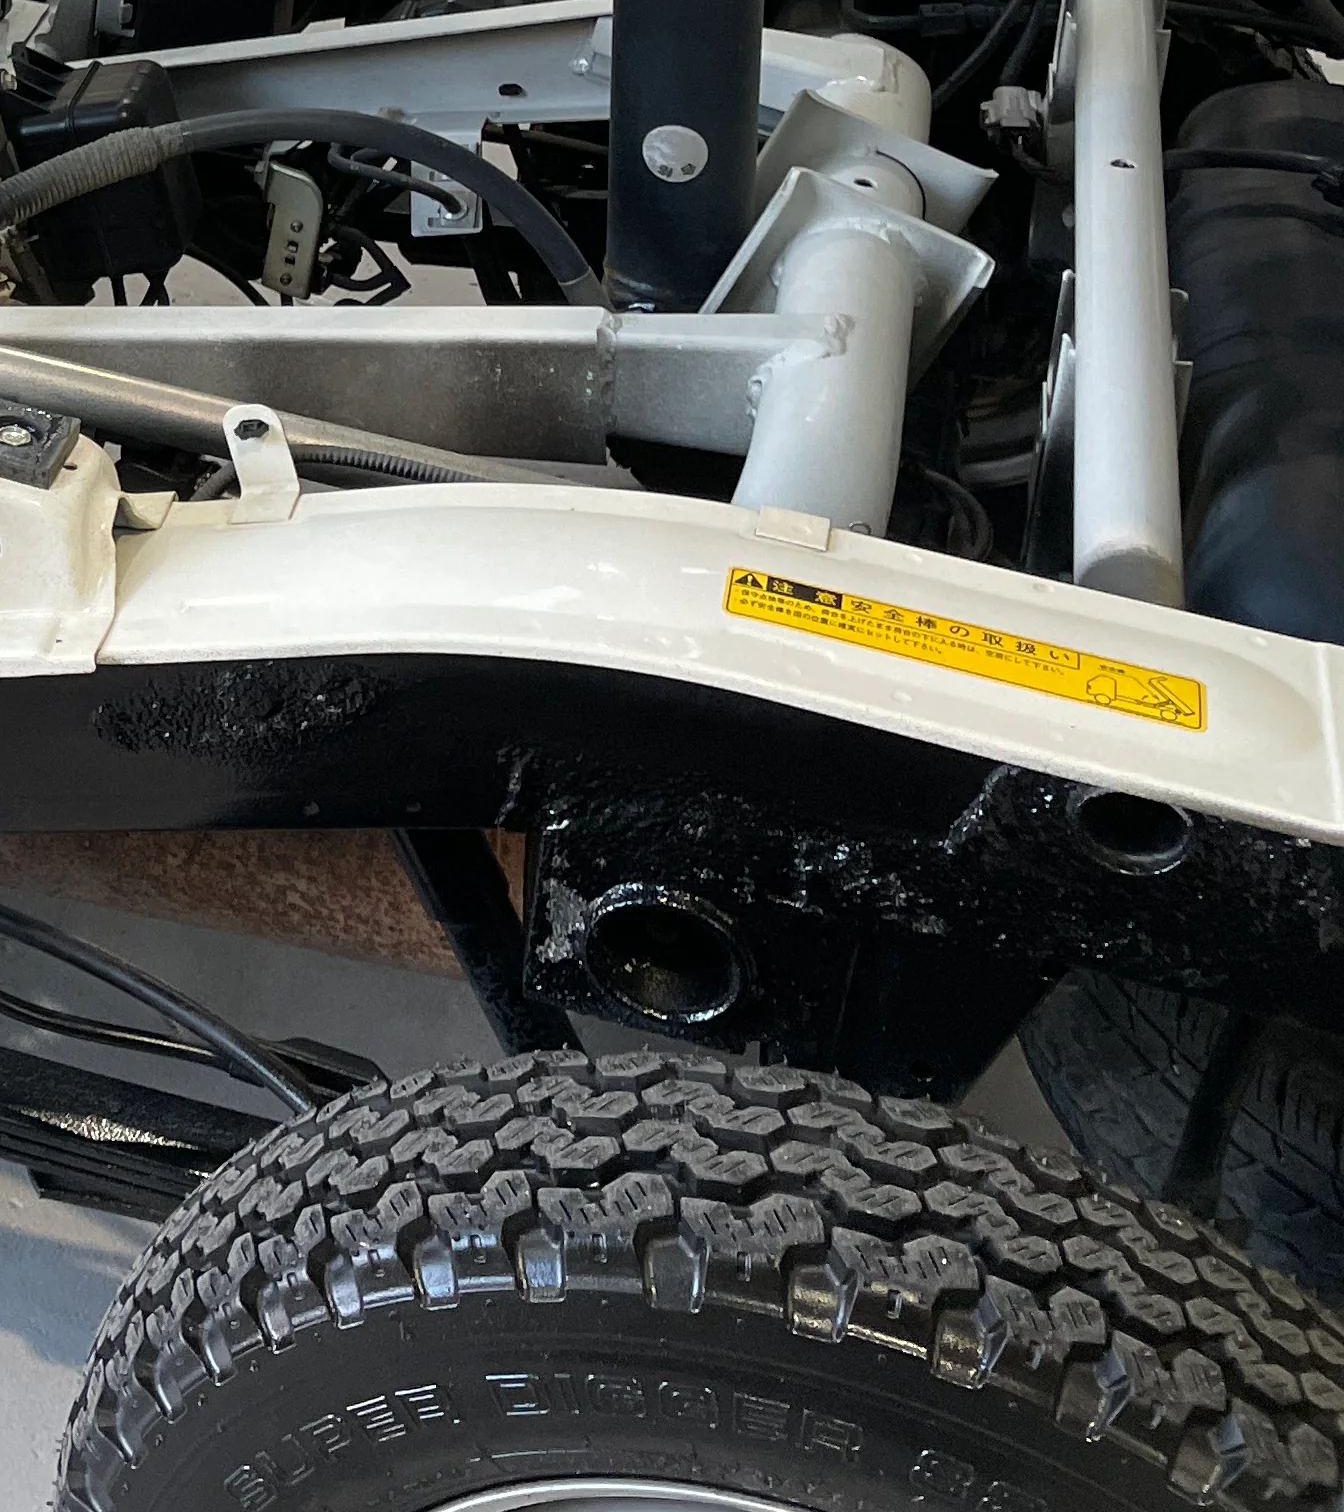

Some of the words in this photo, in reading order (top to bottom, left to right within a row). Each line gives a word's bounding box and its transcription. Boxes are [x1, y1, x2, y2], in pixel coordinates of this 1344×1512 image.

[770, 578, 837, 606] 注意
[849, 598, 1070, 664] 安全棒の取扱い
[223, 1383, 461, 1511] SUPER
[485, 1372, 865, 1464] DIGGER
